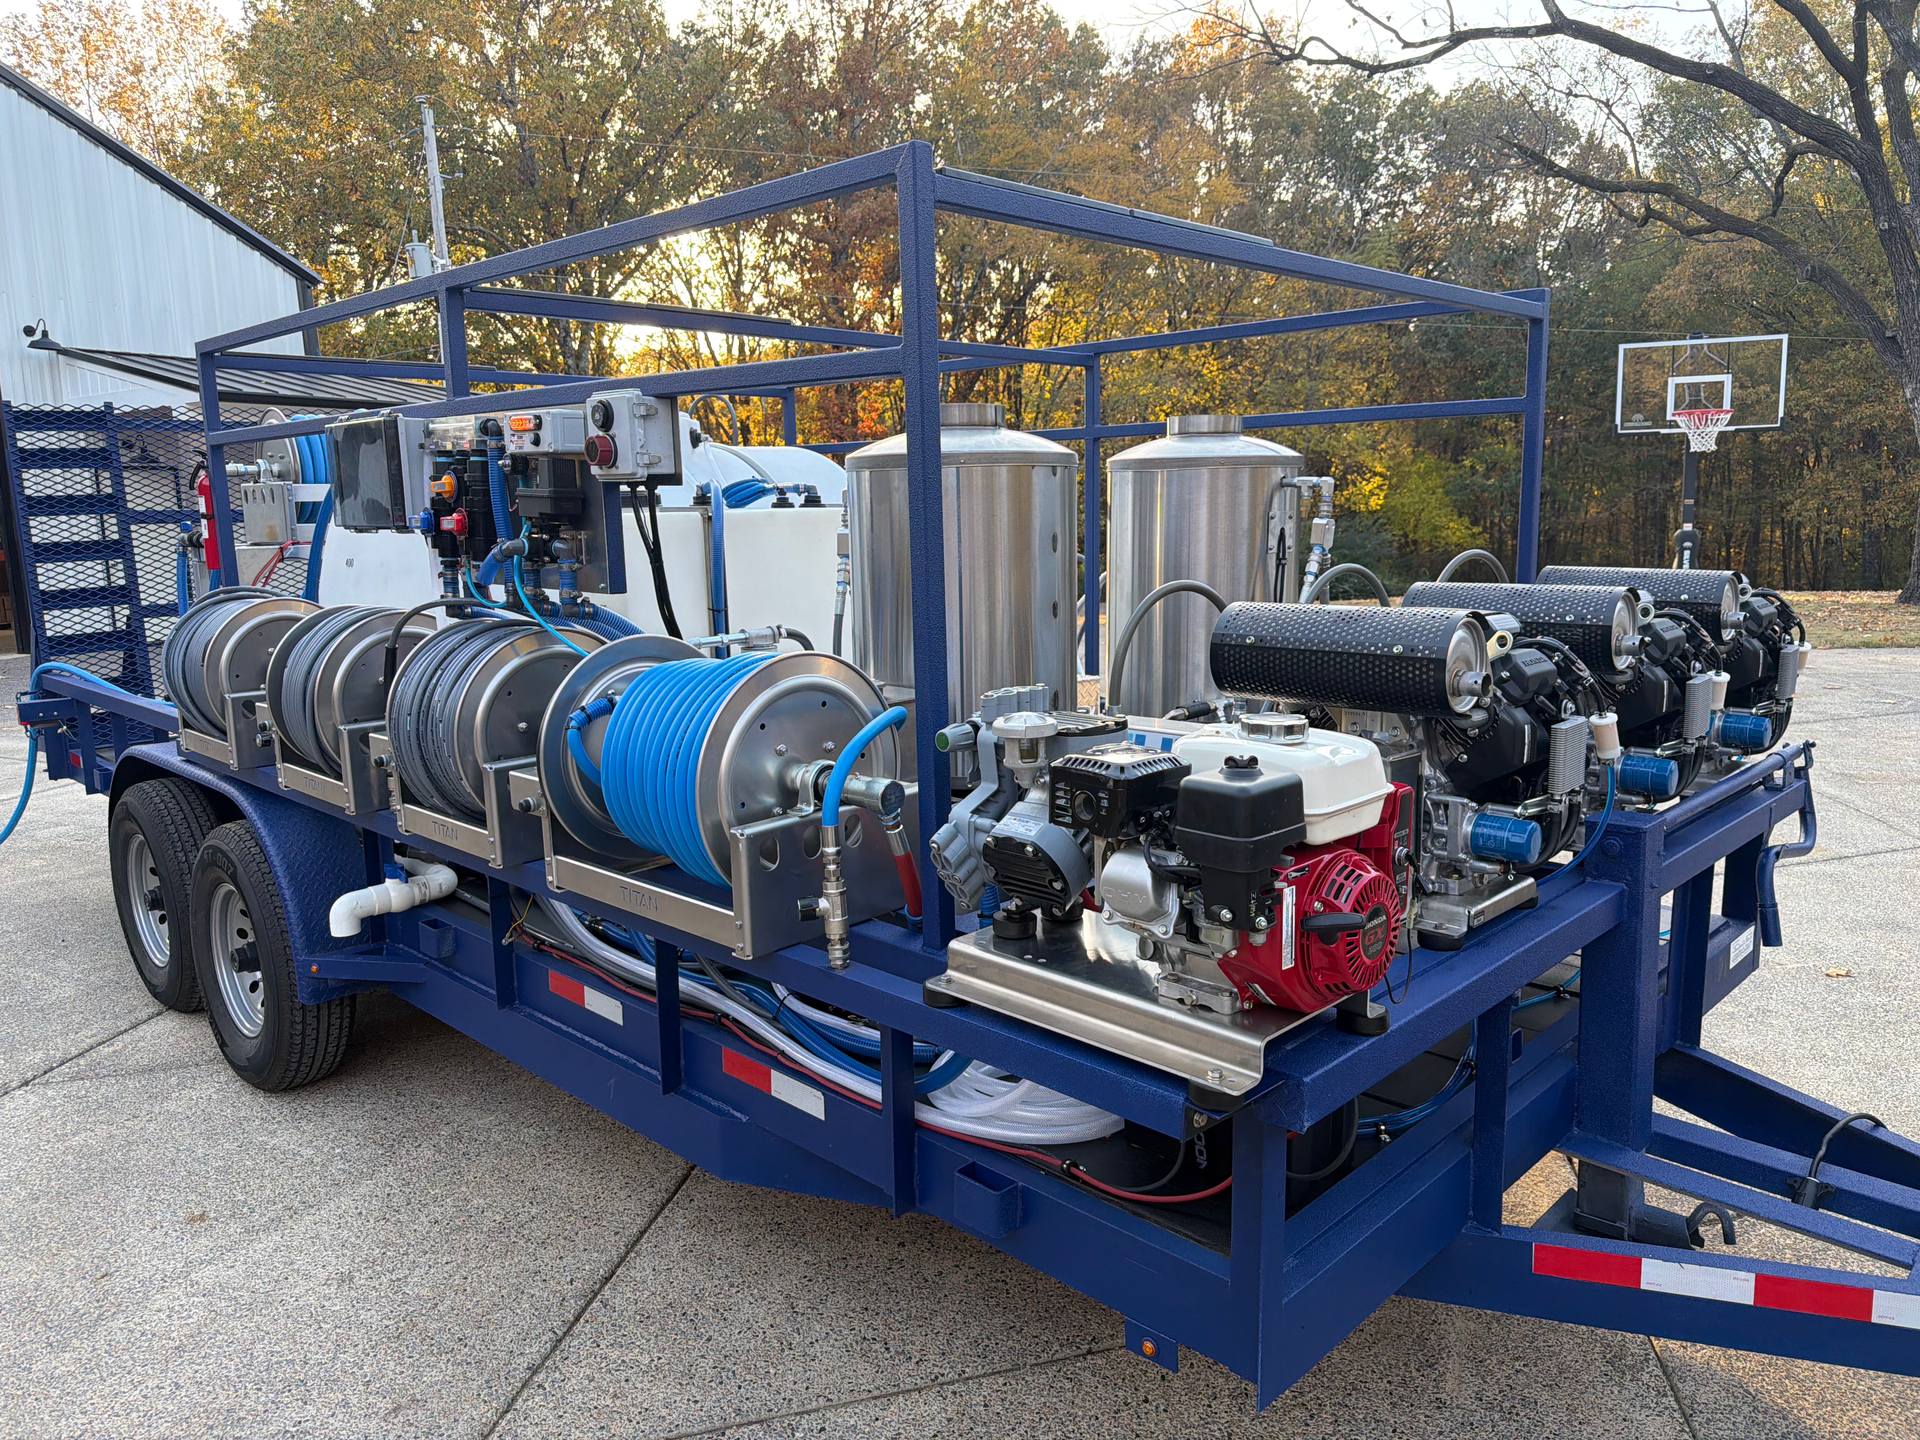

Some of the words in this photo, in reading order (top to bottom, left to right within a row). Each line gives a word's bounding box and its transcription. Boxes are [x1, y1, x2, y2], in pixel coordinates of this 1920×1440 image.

[1521, 656, 1548, 667] HONDA
[431, 820, 458, 841] TITAN
[619, 885, 658, 912] TITAN
[1103, 886, 1147, 903] OHV
[1364, 924, 1386, 946] GX
